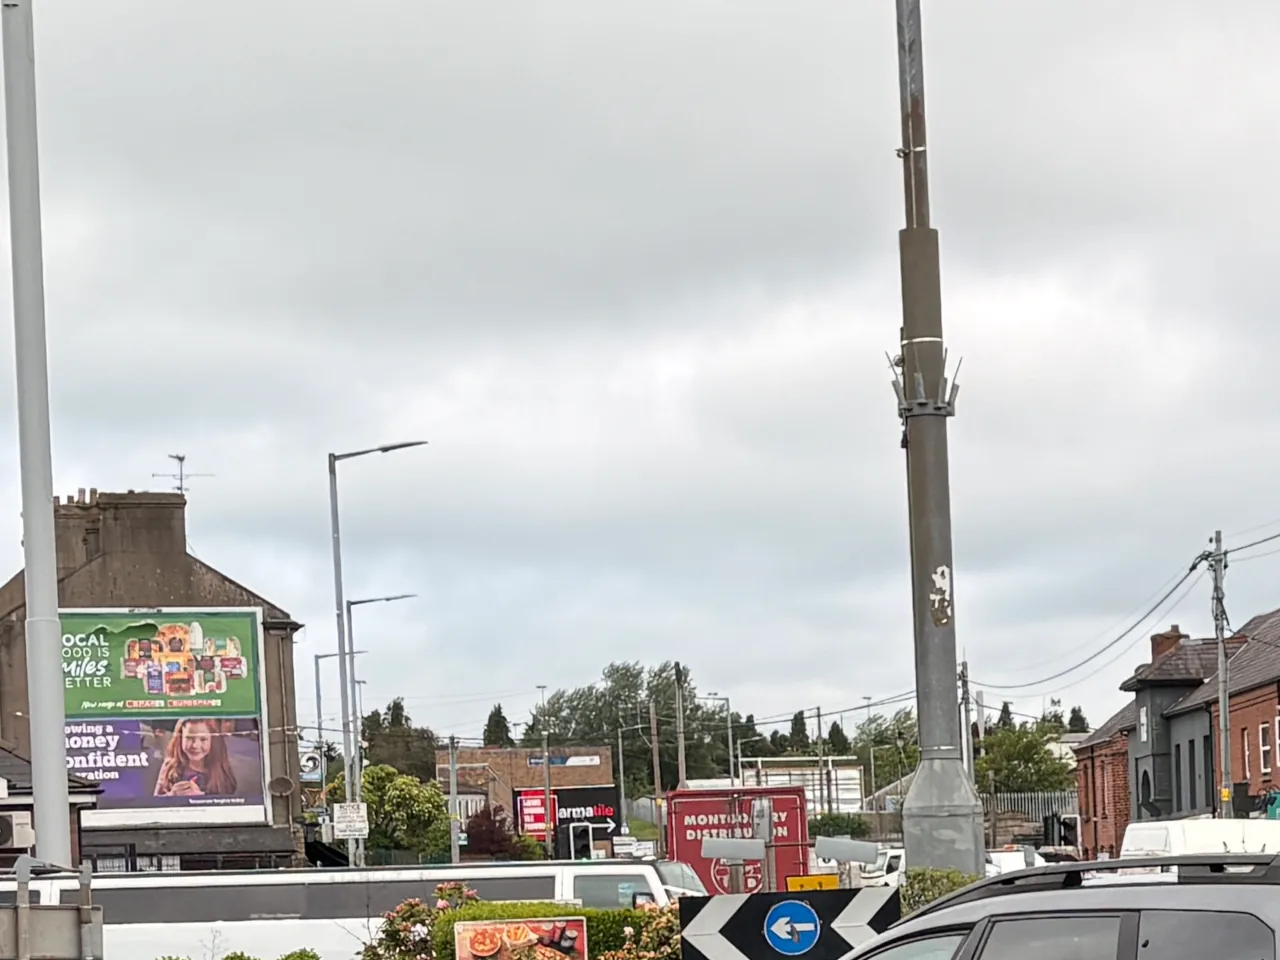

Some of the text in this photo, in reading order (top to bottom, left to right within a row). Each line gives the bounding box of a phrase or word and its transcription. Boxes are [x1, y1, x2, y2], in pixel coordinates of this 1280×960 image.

[62, 633, 110, 647] OCAL
[62, 647, 110, 658] OOD IS
[65, 676, 112, 689] ETTER
[64, 722, 114, 735] owing a
[65, 750, 149, 769] onfident
[558, 804, 614, 819] armatile
